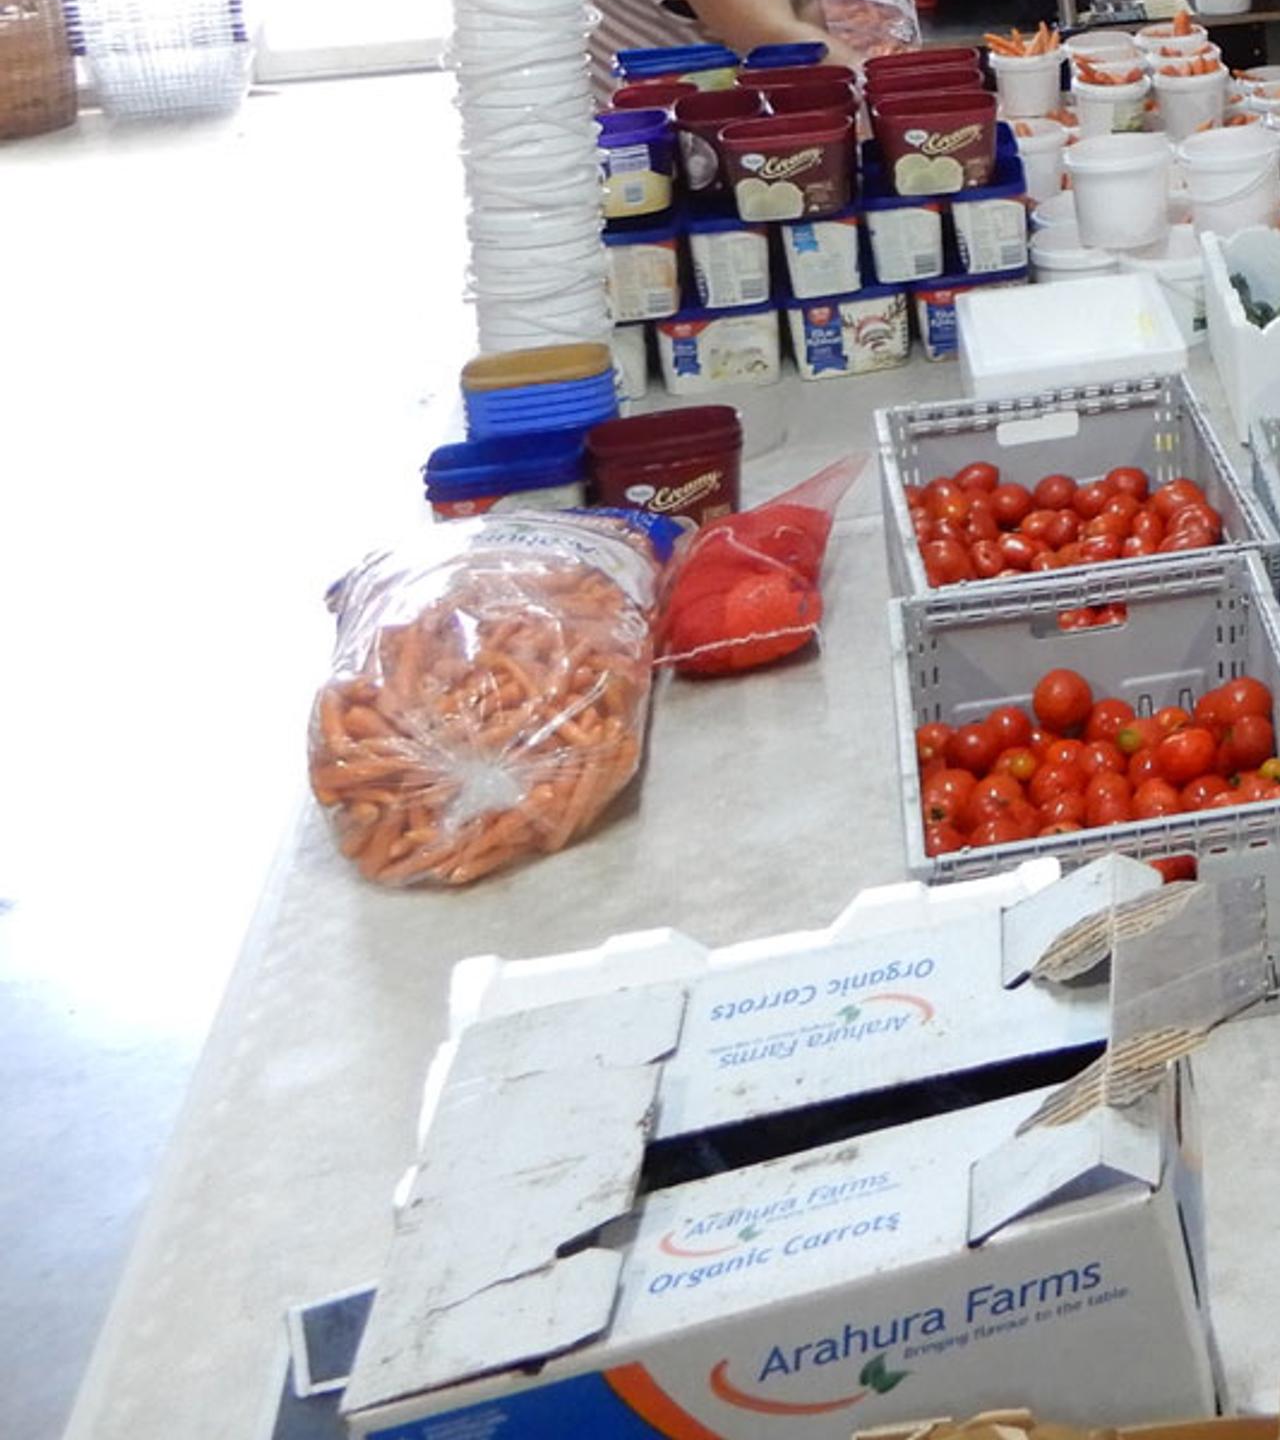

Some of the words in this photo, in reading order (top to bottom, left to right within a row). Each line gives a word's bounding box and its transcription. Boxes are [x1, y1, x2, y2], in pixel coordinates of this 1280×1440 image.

[653, 471, 721, 507] Creamy
[827, 958, 934, 996] Organic
[710, 985, 817, 1021] Carrots
[808, 1012, 912, 1051] Arahura
[718, 1039, 798, 1070] Farms
[684, 1196, 798, 1240] Arahura
[806, 1171, 891, 1205] Farms
[647, 1246, 773, 1294] Organic
[783, 1211, 901, 1257] Carrots
[757, 1306, 946, 1383] Arahura
[966, 1261, 1102, 1323] Farms
[904, 1330, 969, 1360] Bringing
[974, 1316, 1030, 1341] flavour
[1035, 1309, 1053, 1323] to
[1056, 1299, 1083, 1317] the
[1087, 1286, 1129, 1307] table
